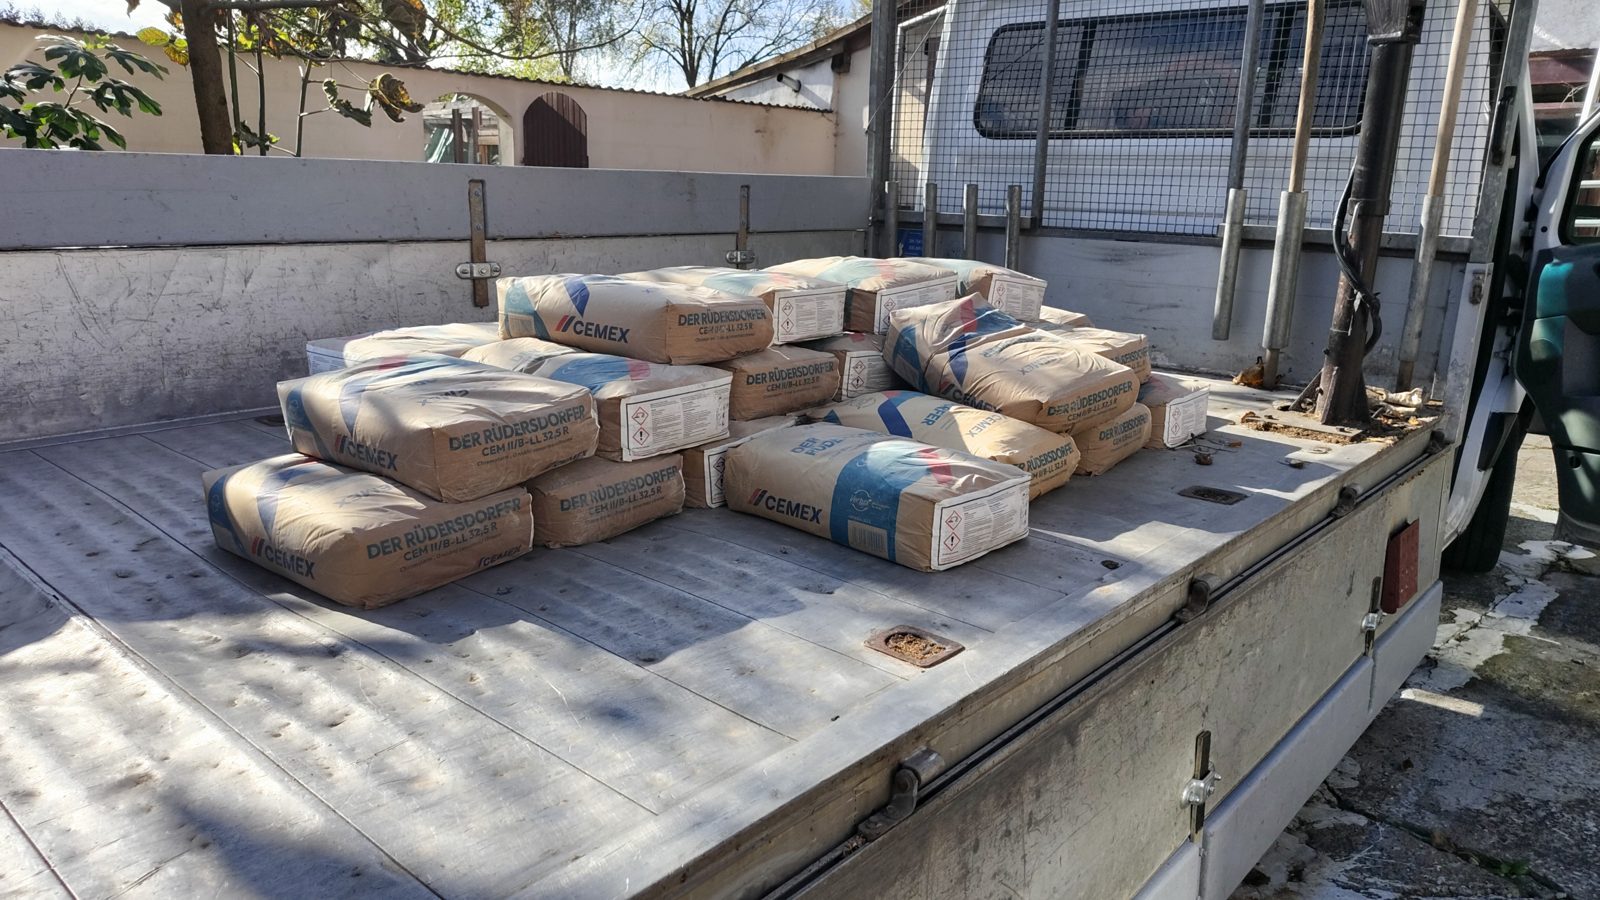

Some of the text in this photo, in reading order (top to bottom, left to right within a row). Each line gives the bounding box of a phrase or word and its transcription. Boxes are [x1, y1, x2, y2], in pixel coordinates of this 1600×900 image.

[573, 320, 630, 343] CEMEX
[678, 313, 700, 326] DER
[746, 361, 834, 386] DER RÜDERSDORFER
[1047, 403, 1069, 416] DER
[1071, 381, 1133, 412] RÜDERSDORFER
[449, 405, 585, 451] DER RÜDERSDORFER
[482, 445, 506, 457] CEM
[543, 430, 561, 441] 32,5
[562, 426, 570, 435] R
[966, 414, 1002, 438] CEMEX
[346, 440, 399, 471] CEMEX
[560, 493, 587, 512] DER
[589, 465, 678, 504] RÜDERSDORFER
[589, 503, 608, 515] CEM
[765, 495, 823, 524] CEMEX
[367, 536, 403, 560] DER
[404, 497, 521, 547] RÜDERSDORFER
[404, 547, 429, 561] CEM
[468, 526, 490, 540] 32,5
[491, 521, 498, 531] R
[264, 544, 315, 580] CEMEX
